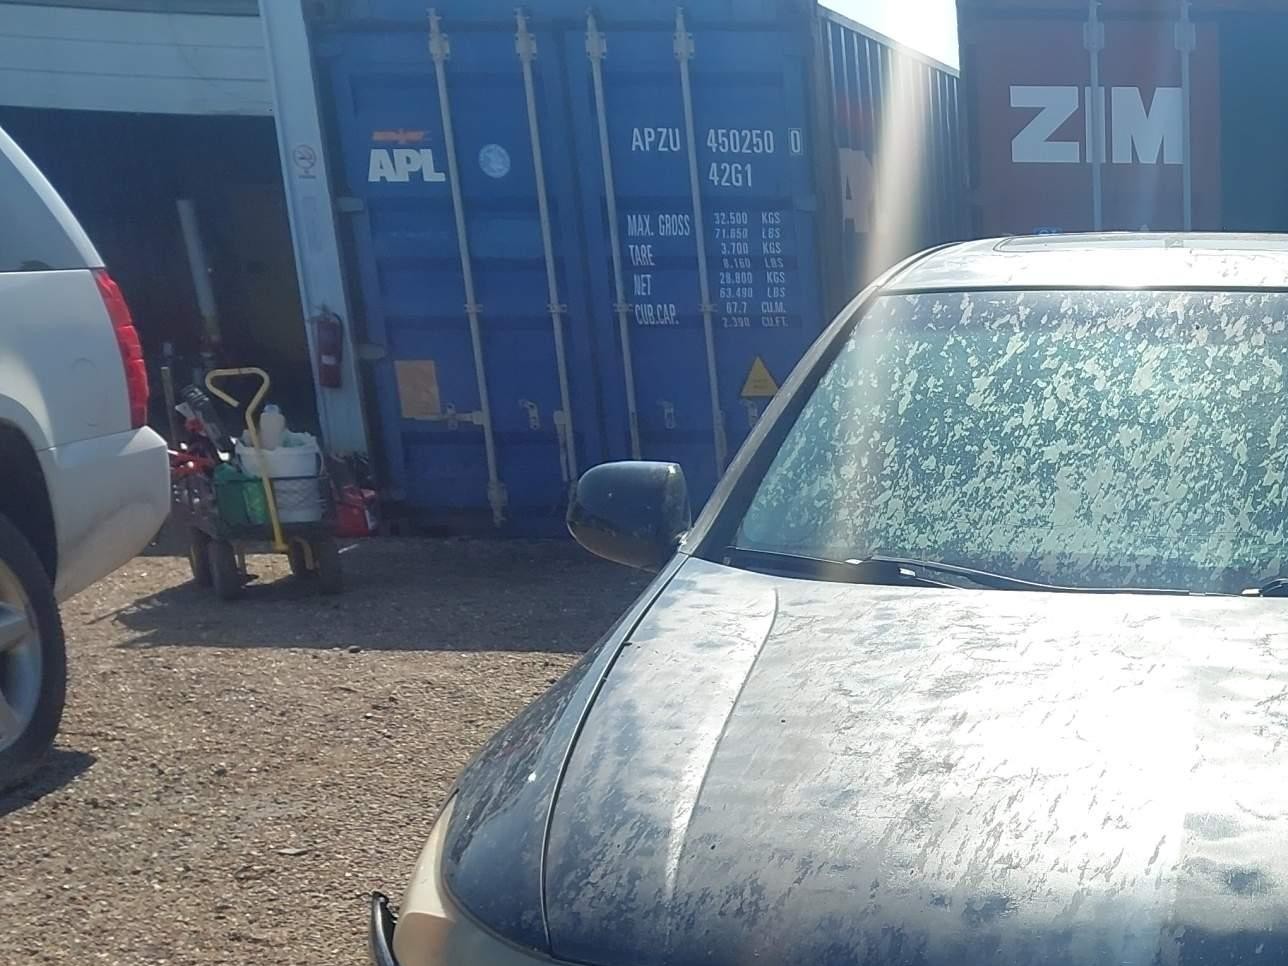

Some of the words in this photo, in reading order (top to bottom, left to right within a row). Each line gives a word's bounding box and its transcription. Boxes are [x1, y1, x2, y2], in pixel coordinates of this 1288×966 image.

[1010, 86, 1184, 164] ZIM
[632, 127, 681, 151] APZU
[707, 128, 775, 153] 450250
[368, 149, 446, 182] APL
[708, 162, 752, 187] 42G1
[627, 214, 654, 236] MAX.
[658, 214, 690, 236] GROSS
[714, 211, 748, 225] 32.500
[762, 211, 781, 225] KGS
[762, 227, 781, 239] LBS
[629, 244, 655, 266] TARE
[721, 242, 749, 255] 3.700
[762, 242, 782, 255] KGS
[765, 257, 784, 268] LBS
[634, 274, 652, 296] NET
[767, 271, 785, 284] KGS
[767, 287, 786, 298] LBS
[726, 301, 747, 314] 67.7
